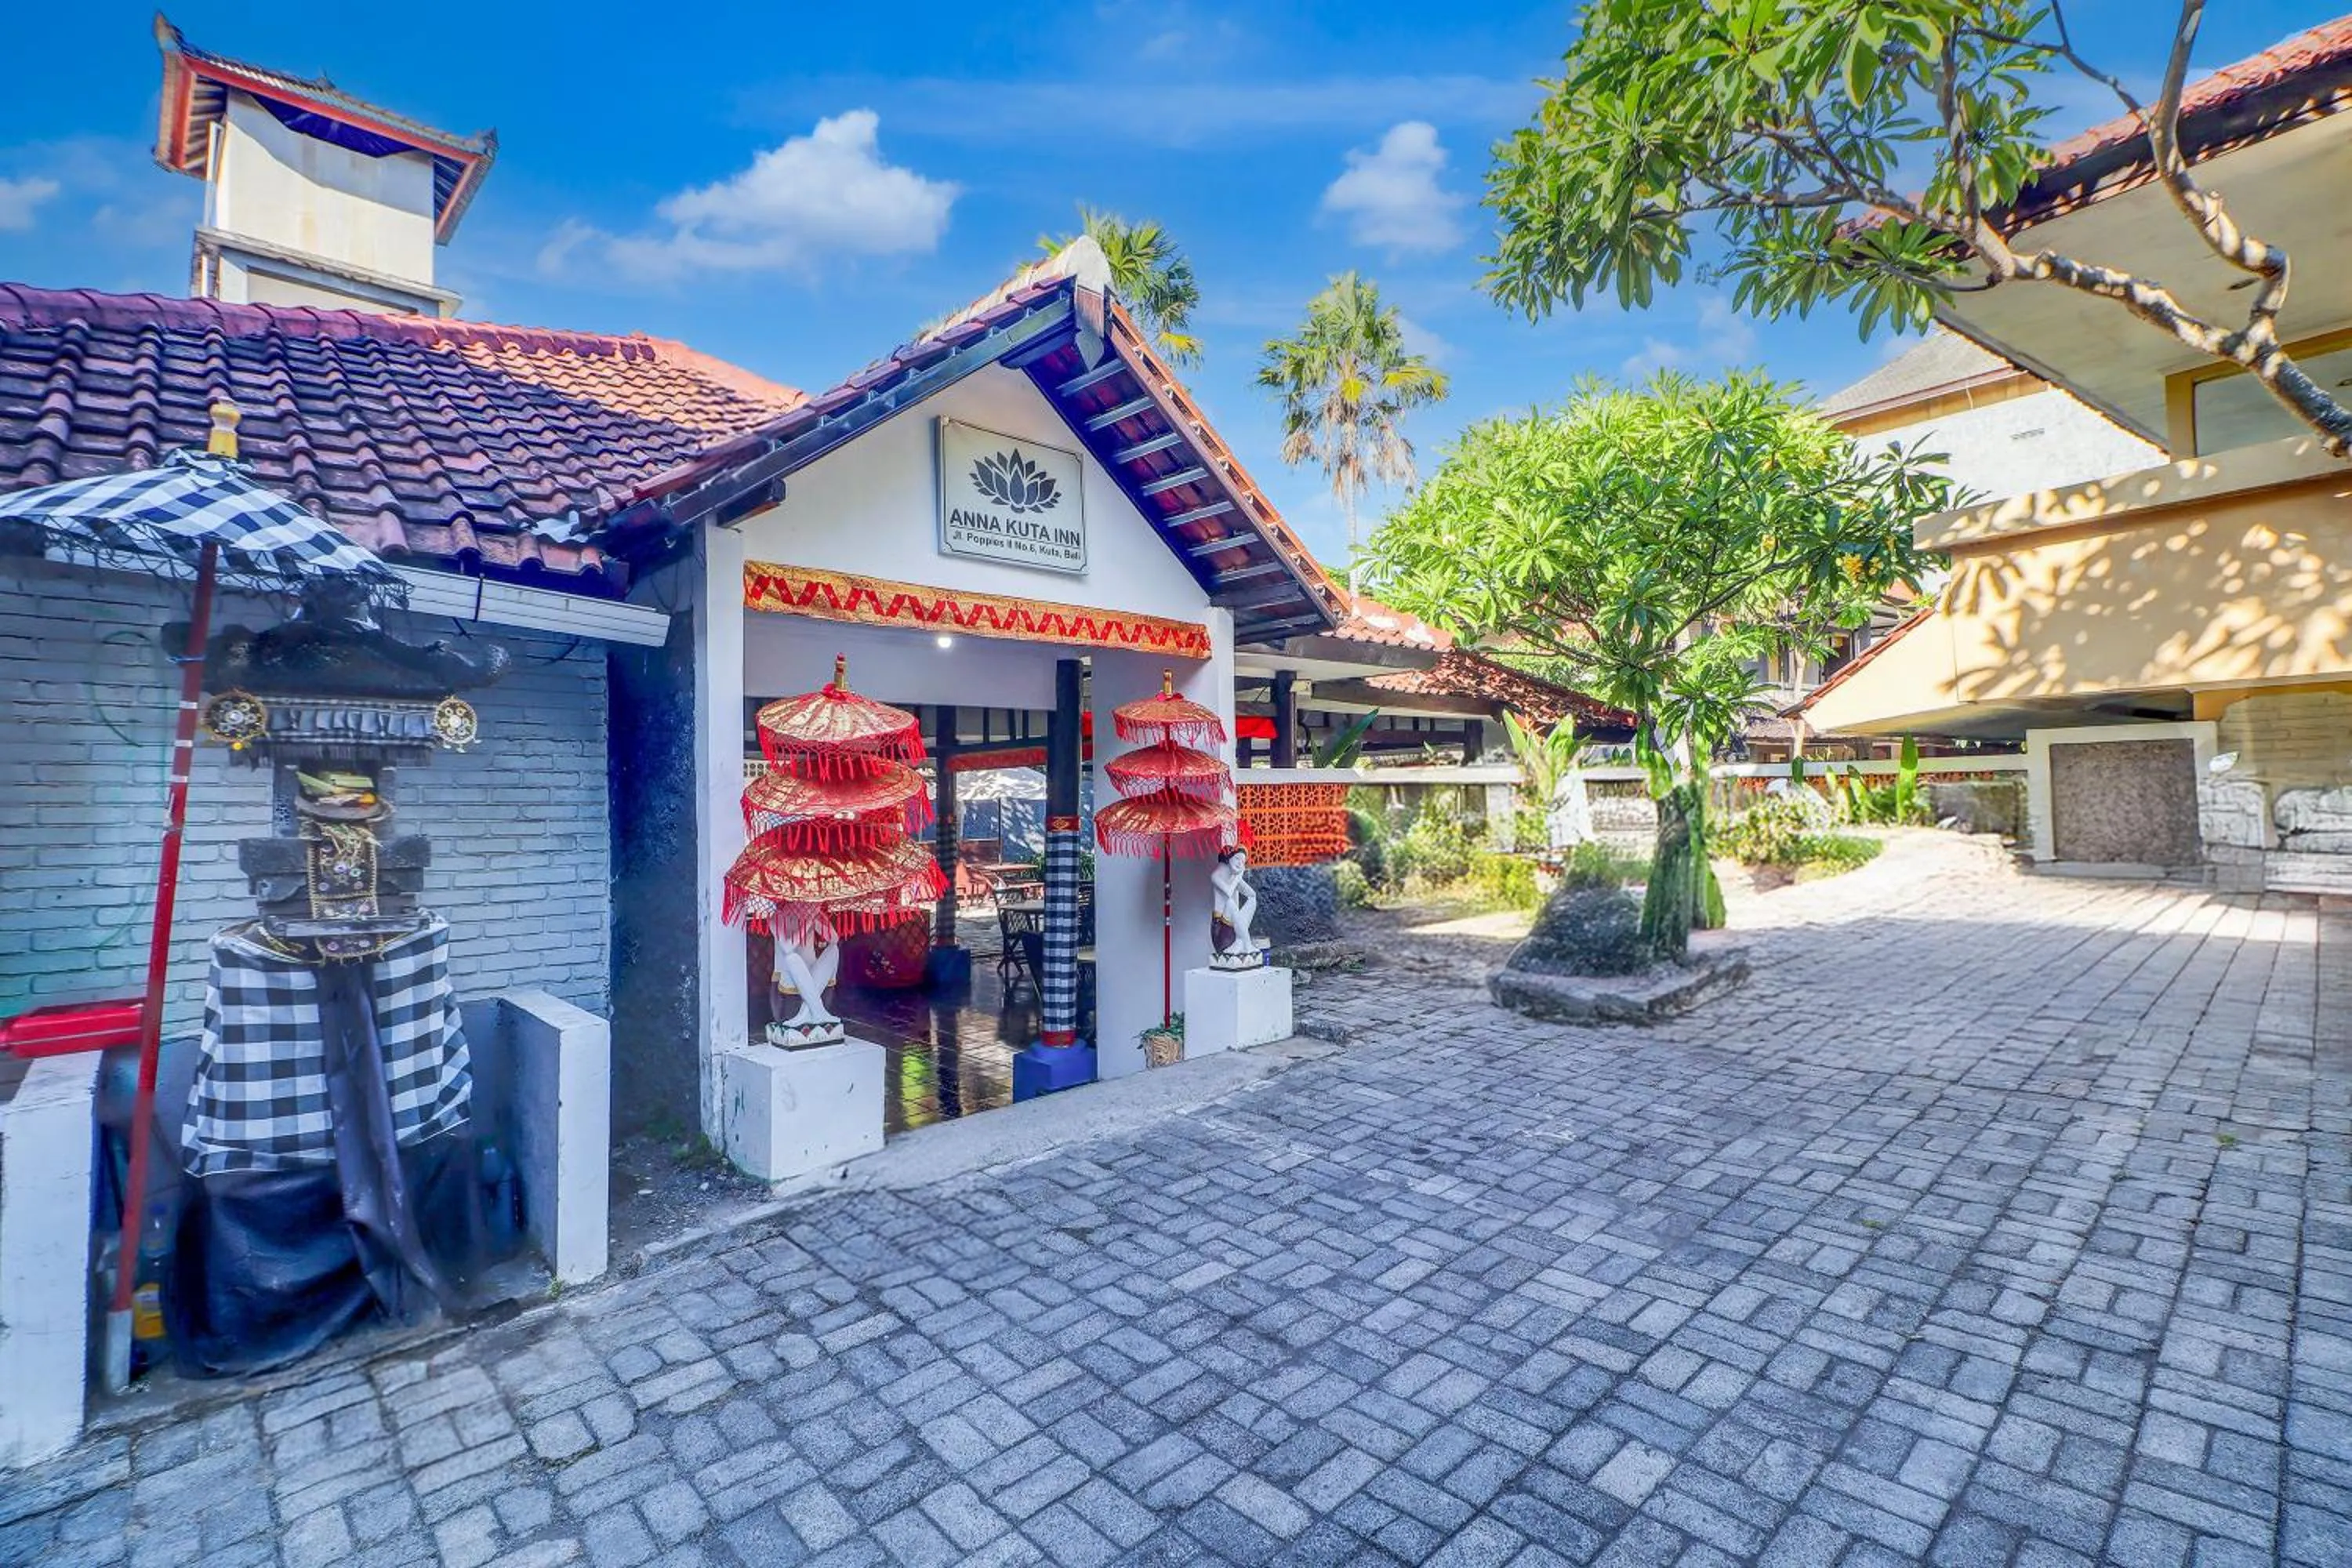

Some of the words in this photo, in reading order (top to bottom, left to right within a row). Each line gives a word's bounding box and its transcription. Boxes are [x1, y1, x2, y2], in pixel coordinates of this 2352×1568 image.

[949, 508, 1001, 532] ANNA
[1006, 518, 1051, 541] KUTA
[1054, 528, 1080, 546] INN
[967, 533, 1004, 548] Poppies
[1039, 545, 1062, 559] Kuta,
[1064, 549, 1081, 561] Bali
